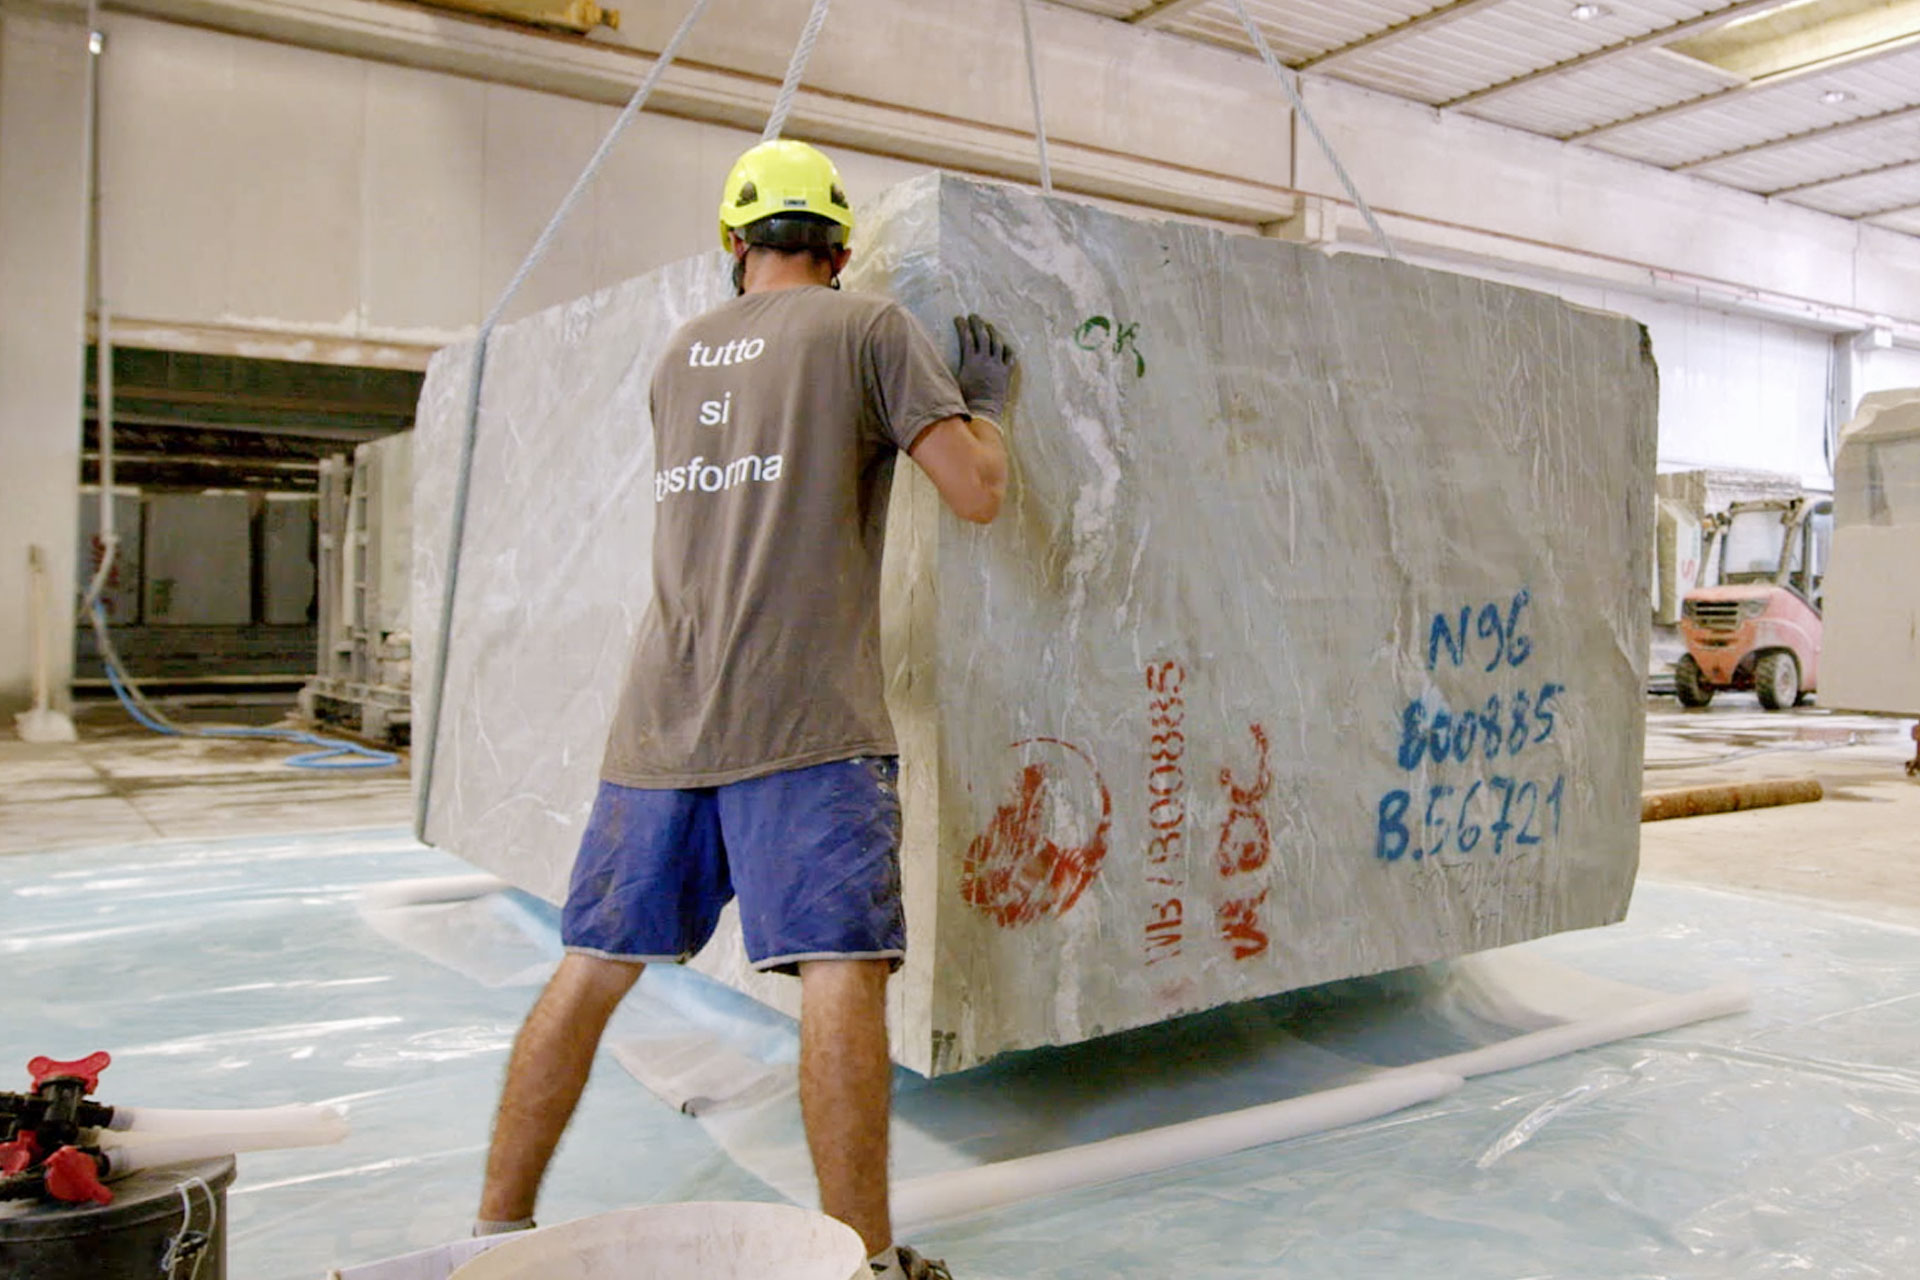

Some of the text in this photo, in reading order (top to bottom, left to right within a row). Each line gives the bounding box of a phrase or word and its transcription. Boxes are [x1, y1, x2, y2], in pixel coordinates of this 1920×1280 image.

[688, 338, 765, 367] tutto
[1074, 315, 1146, 378] OK
[699, 391, 732, 426] si
[1428, 585, 1532, 673] N96
[1377, 774, 1566, 862] B.56721
